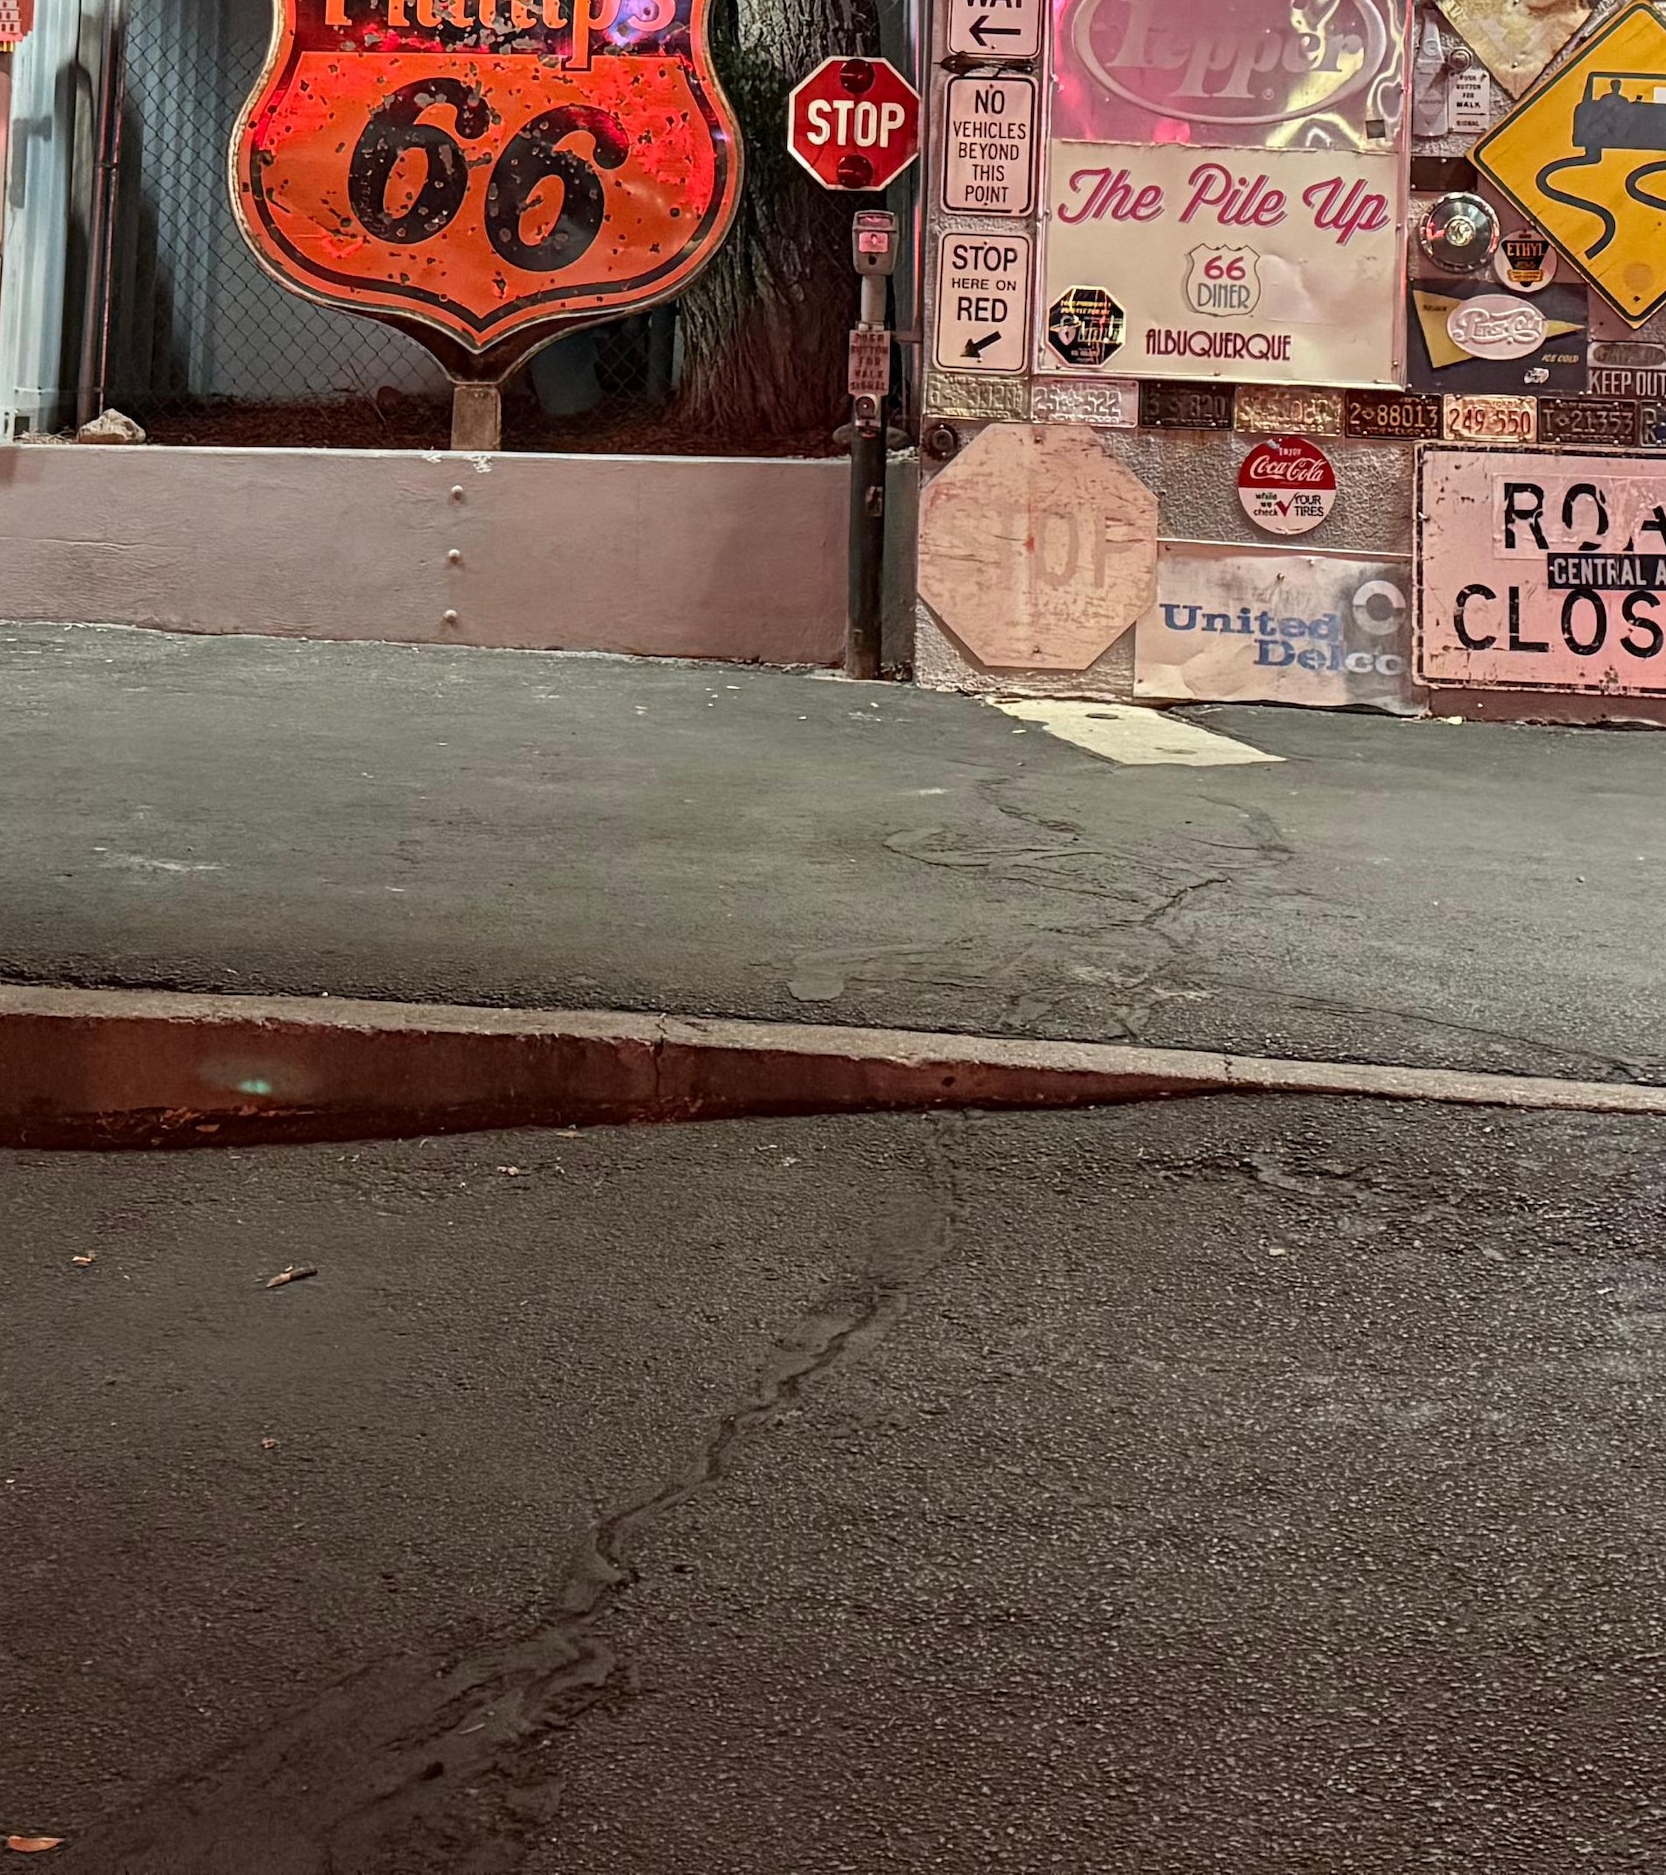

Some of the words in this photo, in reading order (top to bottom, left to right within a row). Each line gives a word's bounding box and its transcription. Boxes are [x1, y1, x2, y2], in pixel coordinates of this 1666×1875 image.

[974, 89, 1005, 114] NO
[806, 99, 905, 149] STOP
[953, 122, 1027, 140] VEHICLES
[958, 143, 1020, 161] BEYOND
[348, 77, 629, 272] 66
[972, 164, 1005, 182] THIS
[965, 186, 1008, 204] POINT
[1057, 167, 1164, 224] The
[1179, 162, 1288, 227] Pile
[1302, 176, 1390, 245] Up
[952, 244, 1018, 272] STOP
[1204, 255, 1246, 281] 66
[951, 278, 991, 291] HERE
[996, 279, 1017, 291] ON
[1197, 283, 1250, 310] DINER
[956, 296, 1008, 323] RED
[1145, 328, 1292, 362] ALBUQUERQUE
[1589, 371, 1631, 396] KEEP
[1554, 558, 1646, 586] CENTRAL
